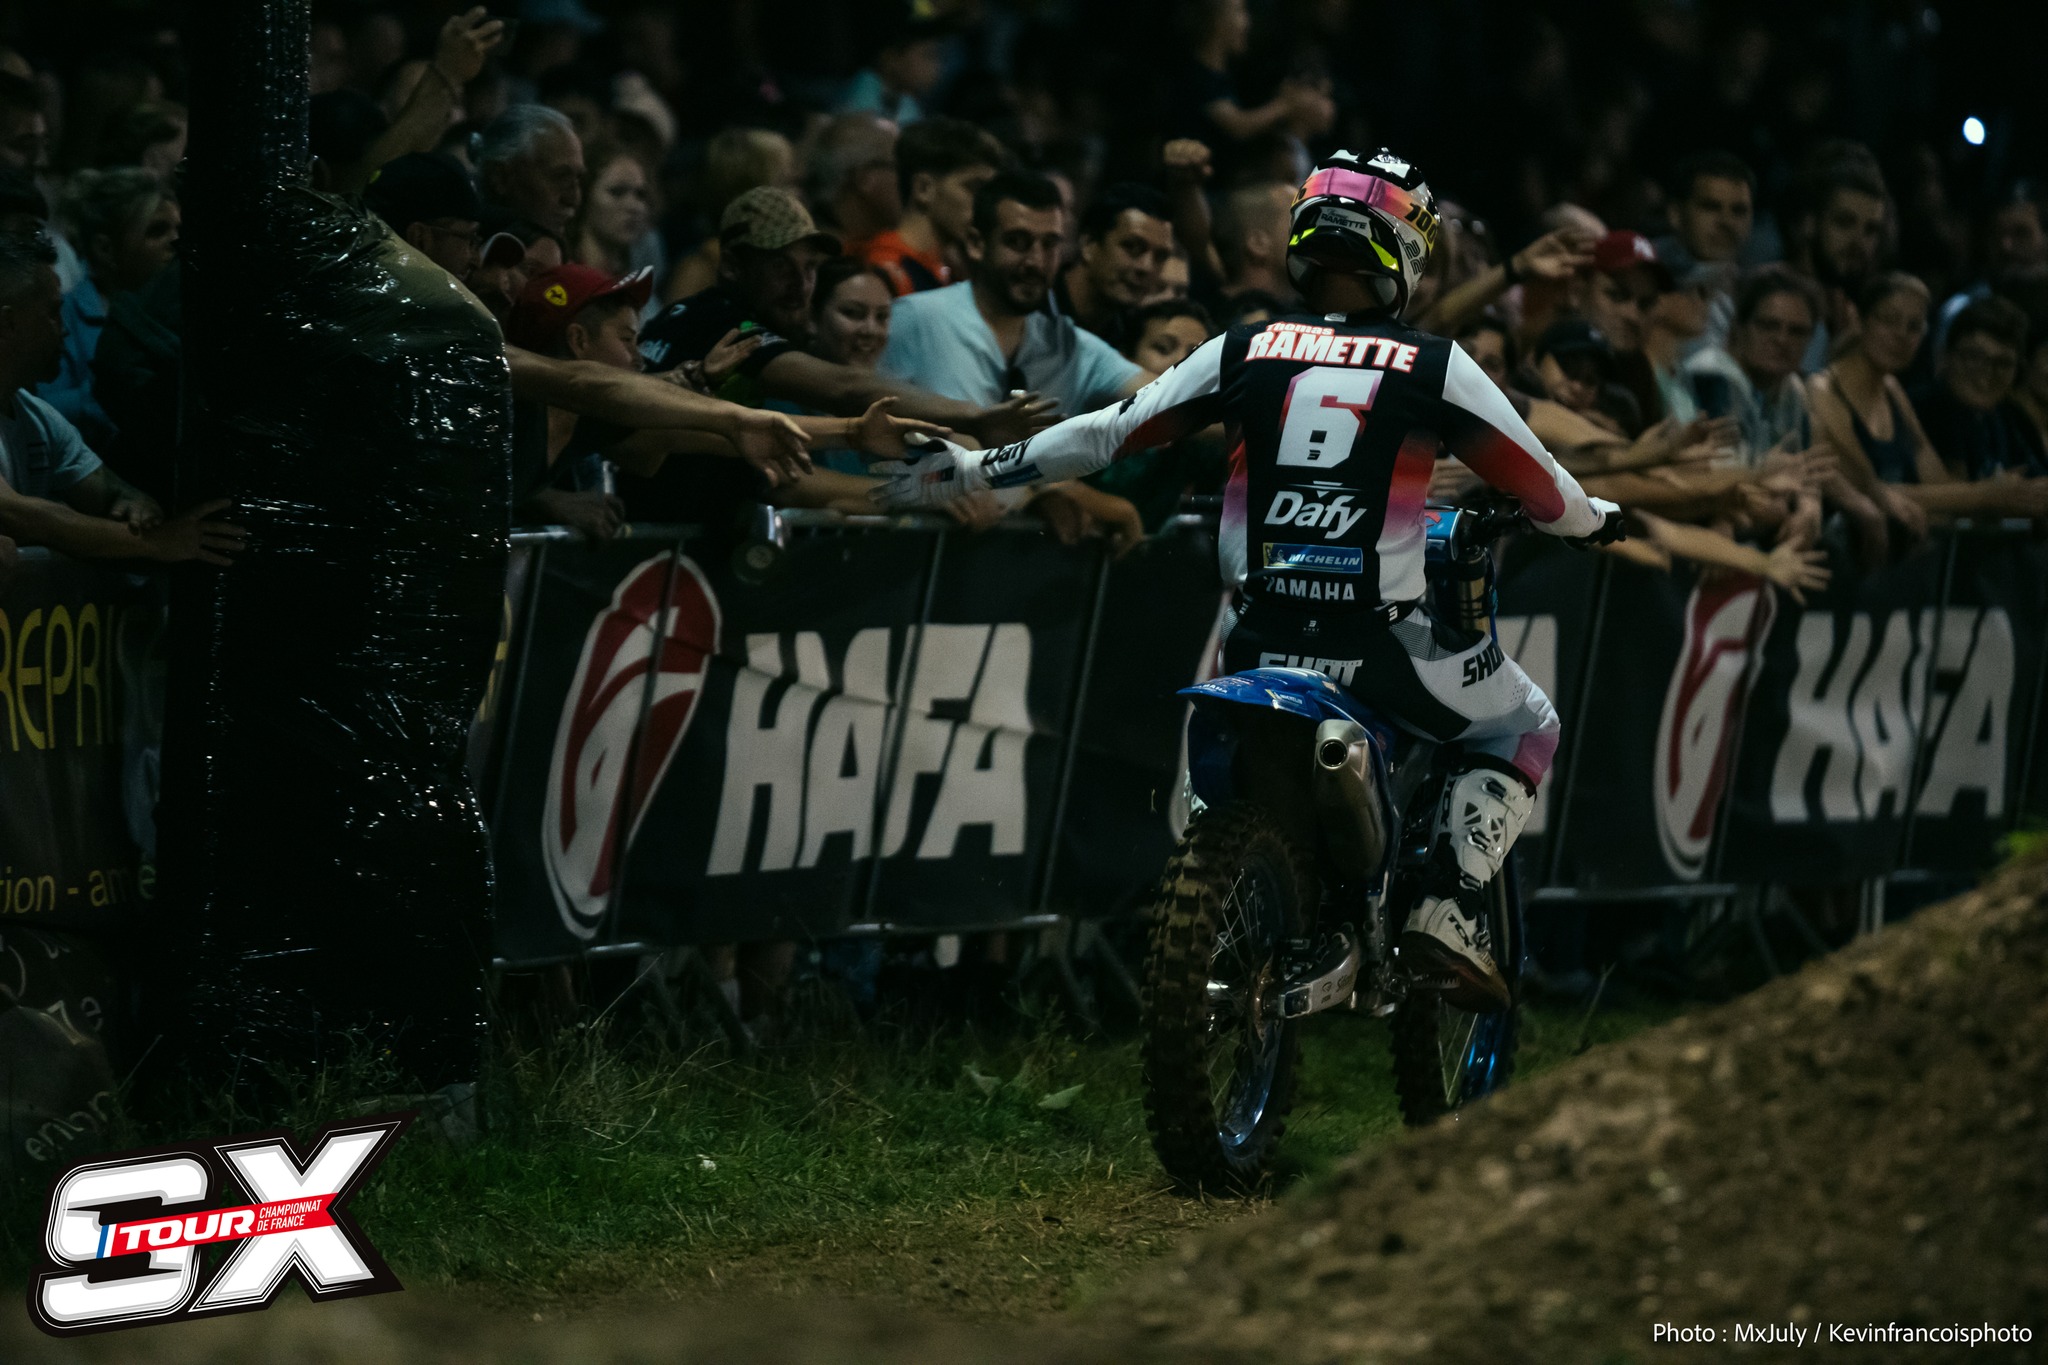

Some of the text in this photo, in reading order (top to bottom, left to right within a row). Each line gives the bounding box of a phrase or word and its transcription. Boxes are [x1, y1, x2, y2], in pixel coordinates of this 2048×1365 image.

[1320, 213, 1368, 229] RAMETTE
[1244, 331, 1419, 373] RAMETTE
[1276, 366, 1384, 468] 6
[1263, 490, 1368, 539] Dafy
[1288, 553, 1361, 566] MICHELIN
[1263, 576, 1355, 600] YAMAHA
[1462, 645, 1505, 688] SHO
[705, 622, 1032, 876] HAFA
